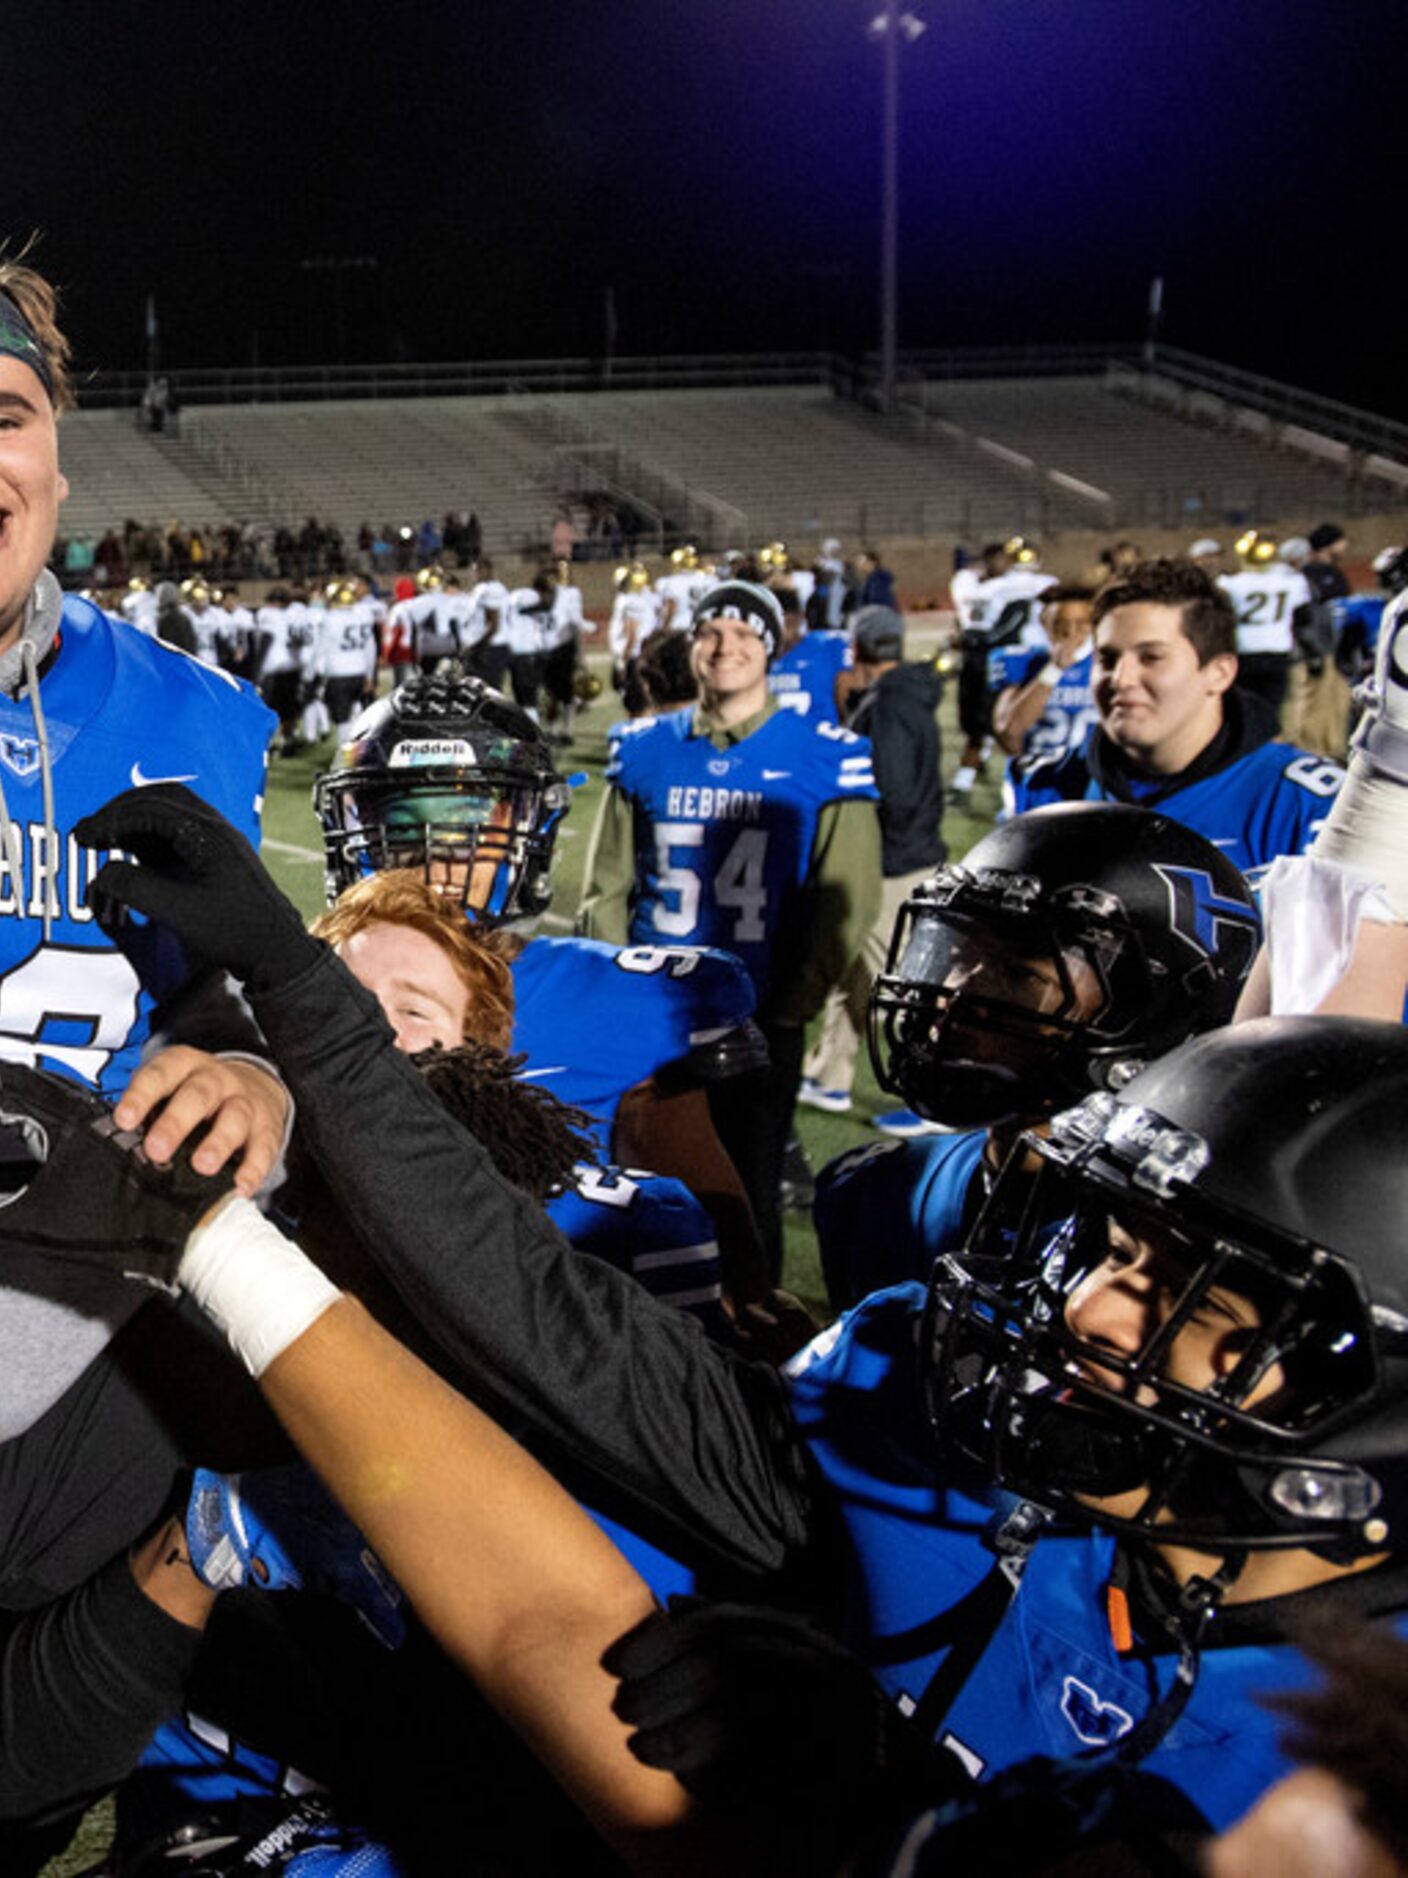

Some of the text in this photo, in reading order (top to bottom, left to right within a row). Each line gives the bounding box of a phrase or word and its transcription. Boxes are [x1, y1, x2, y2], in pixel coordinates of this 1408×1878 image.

[1240, 591, 1289, 624] 21
[666, 785, 763, 820] HEBRON
[651, 820, 769, 942] 54
